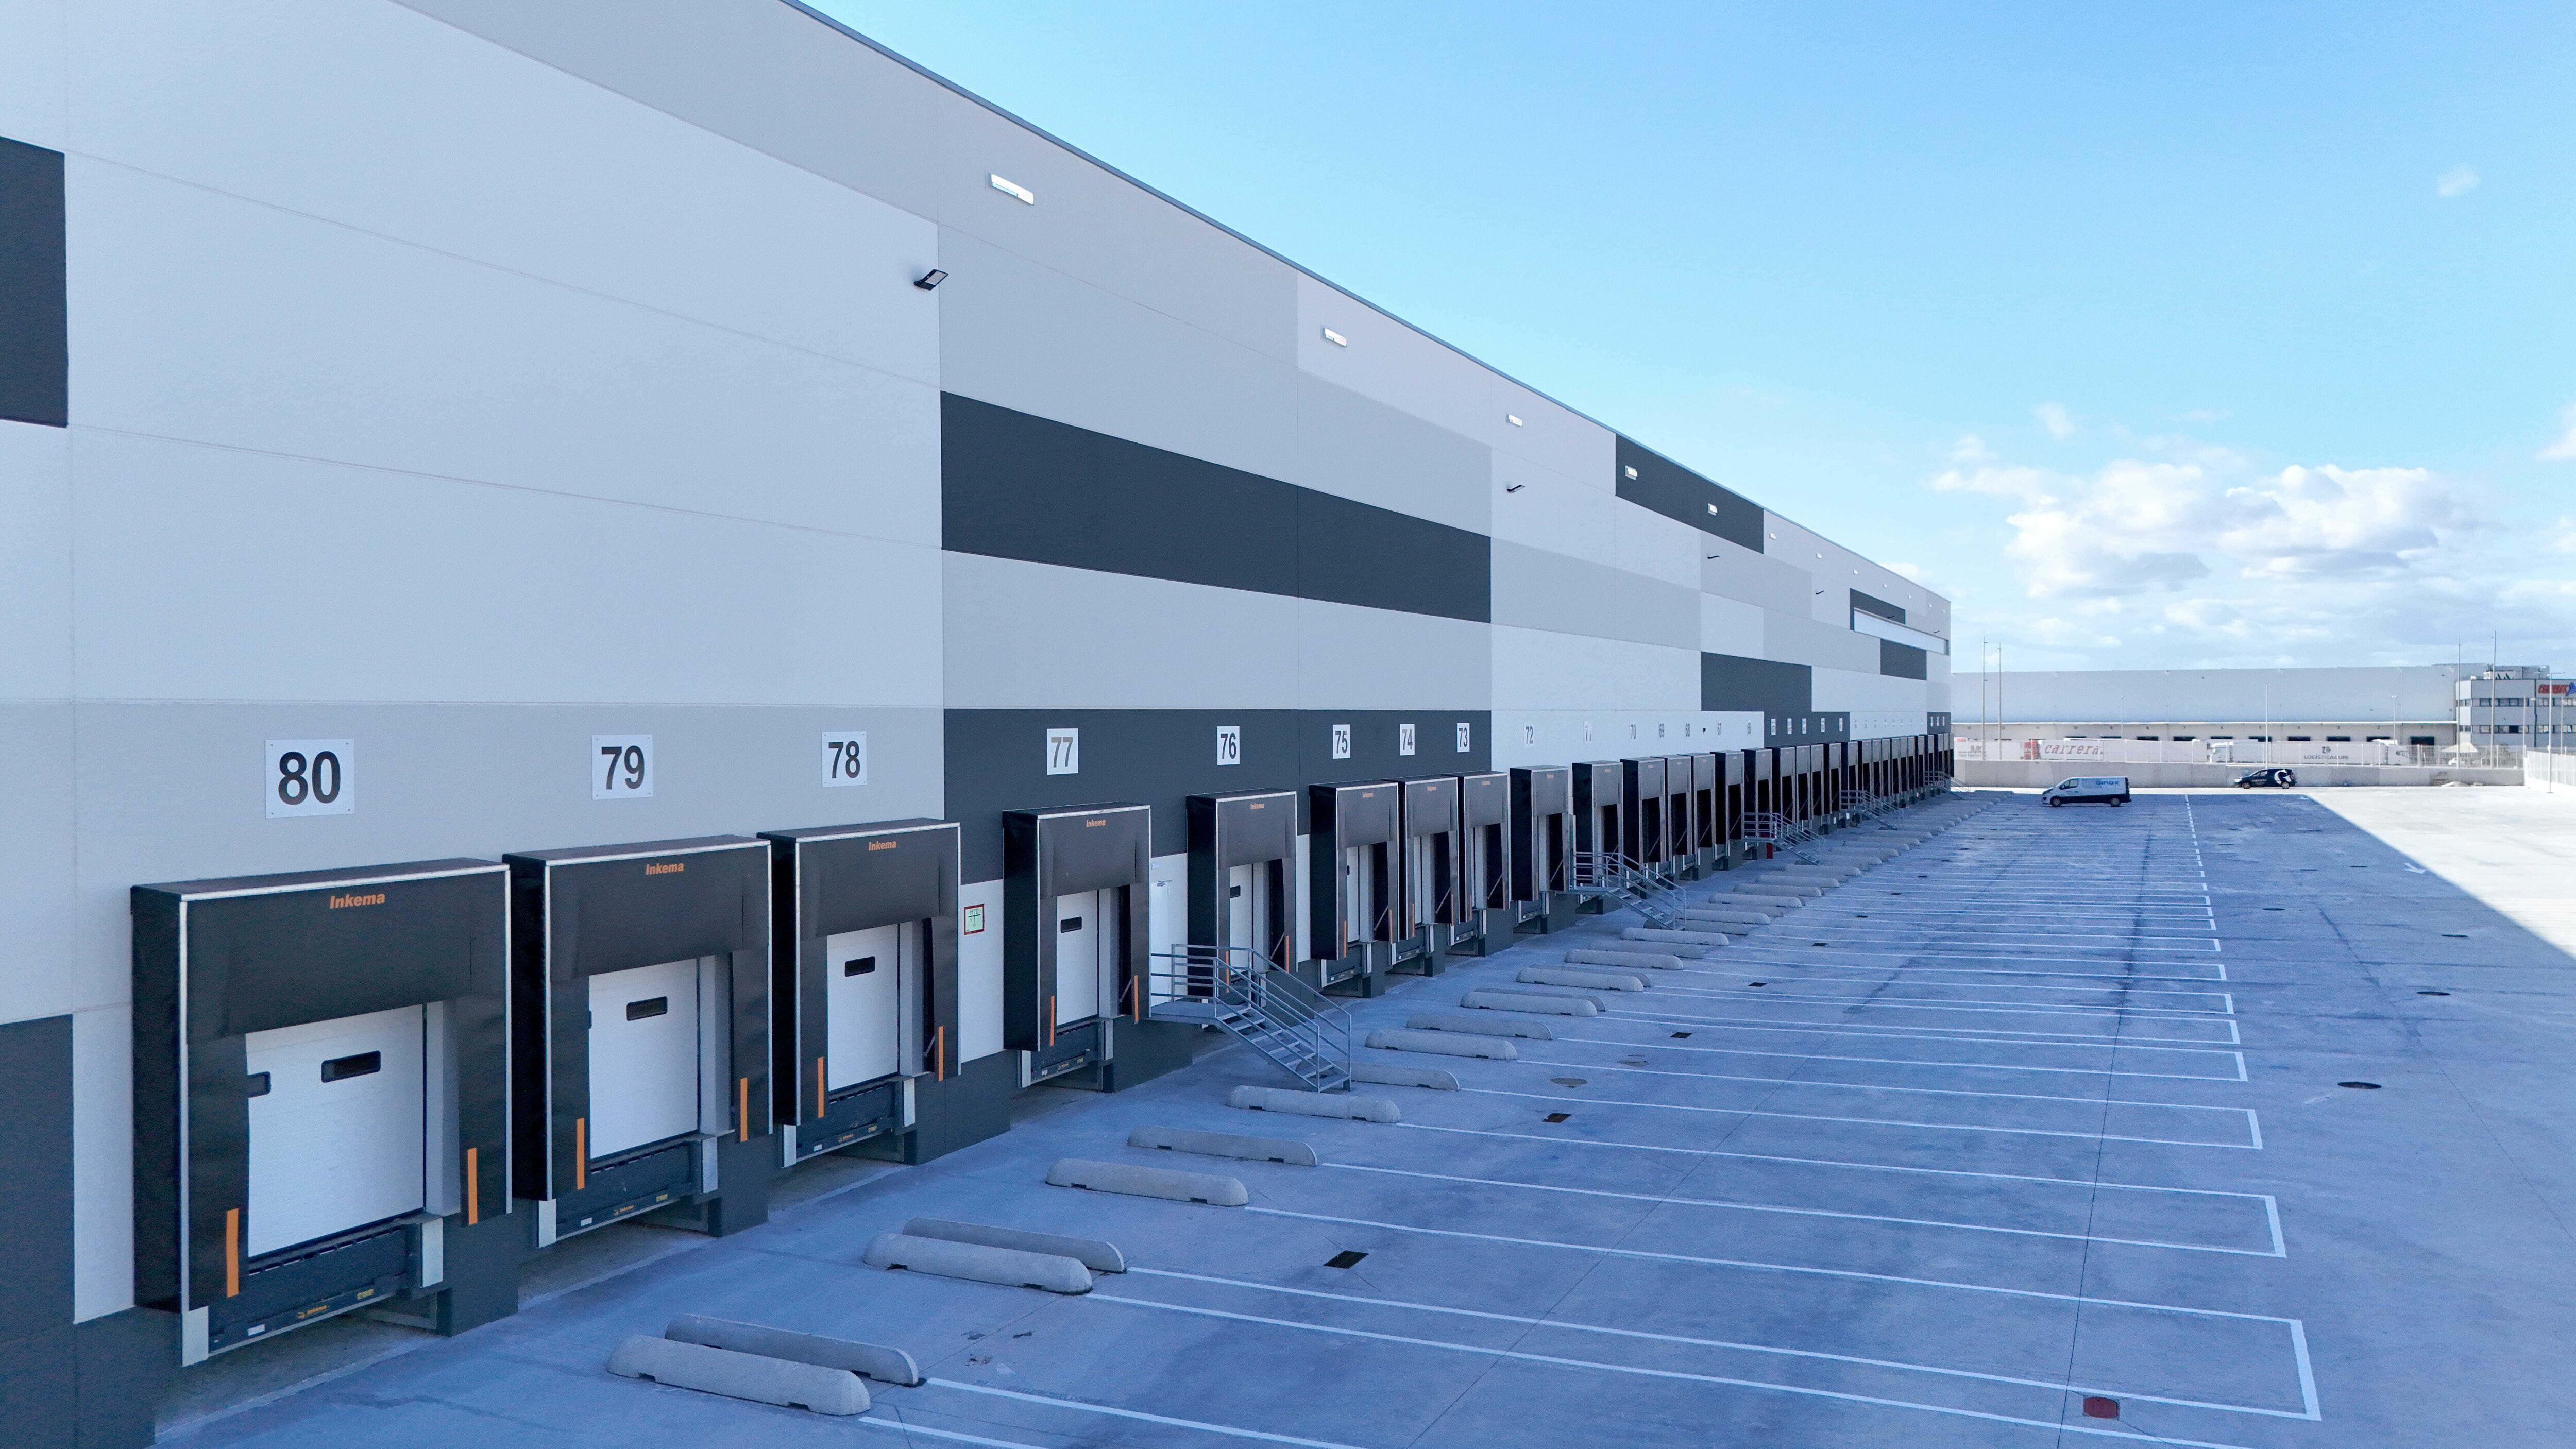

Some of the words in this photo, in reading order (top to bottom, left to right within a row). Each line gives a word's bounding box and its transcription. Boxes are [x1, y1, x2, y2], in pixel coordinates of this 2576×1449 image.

[1335, 730, 1348, 754] 75
[1402, 728, 1413, 751] 74
[1459, 727, 1468, 747] 73
[1525, 726, 1533, 744] 72
[1630, 724, 1636, 739] 70
[1051, 737, 1073, 768] 77
[1220, 732, 1236, 759] 76
[601, 745, 645, 790] 79
[828, 741, 860, 779] 78
[278, 751, 341, 805] 80
[1086, 819, 1106, 827] Inkema
[868, 841, 897, 851] Inkema
[646, 862, 684, 876] Inkema
[329, 892, 385, 909] Inkema
